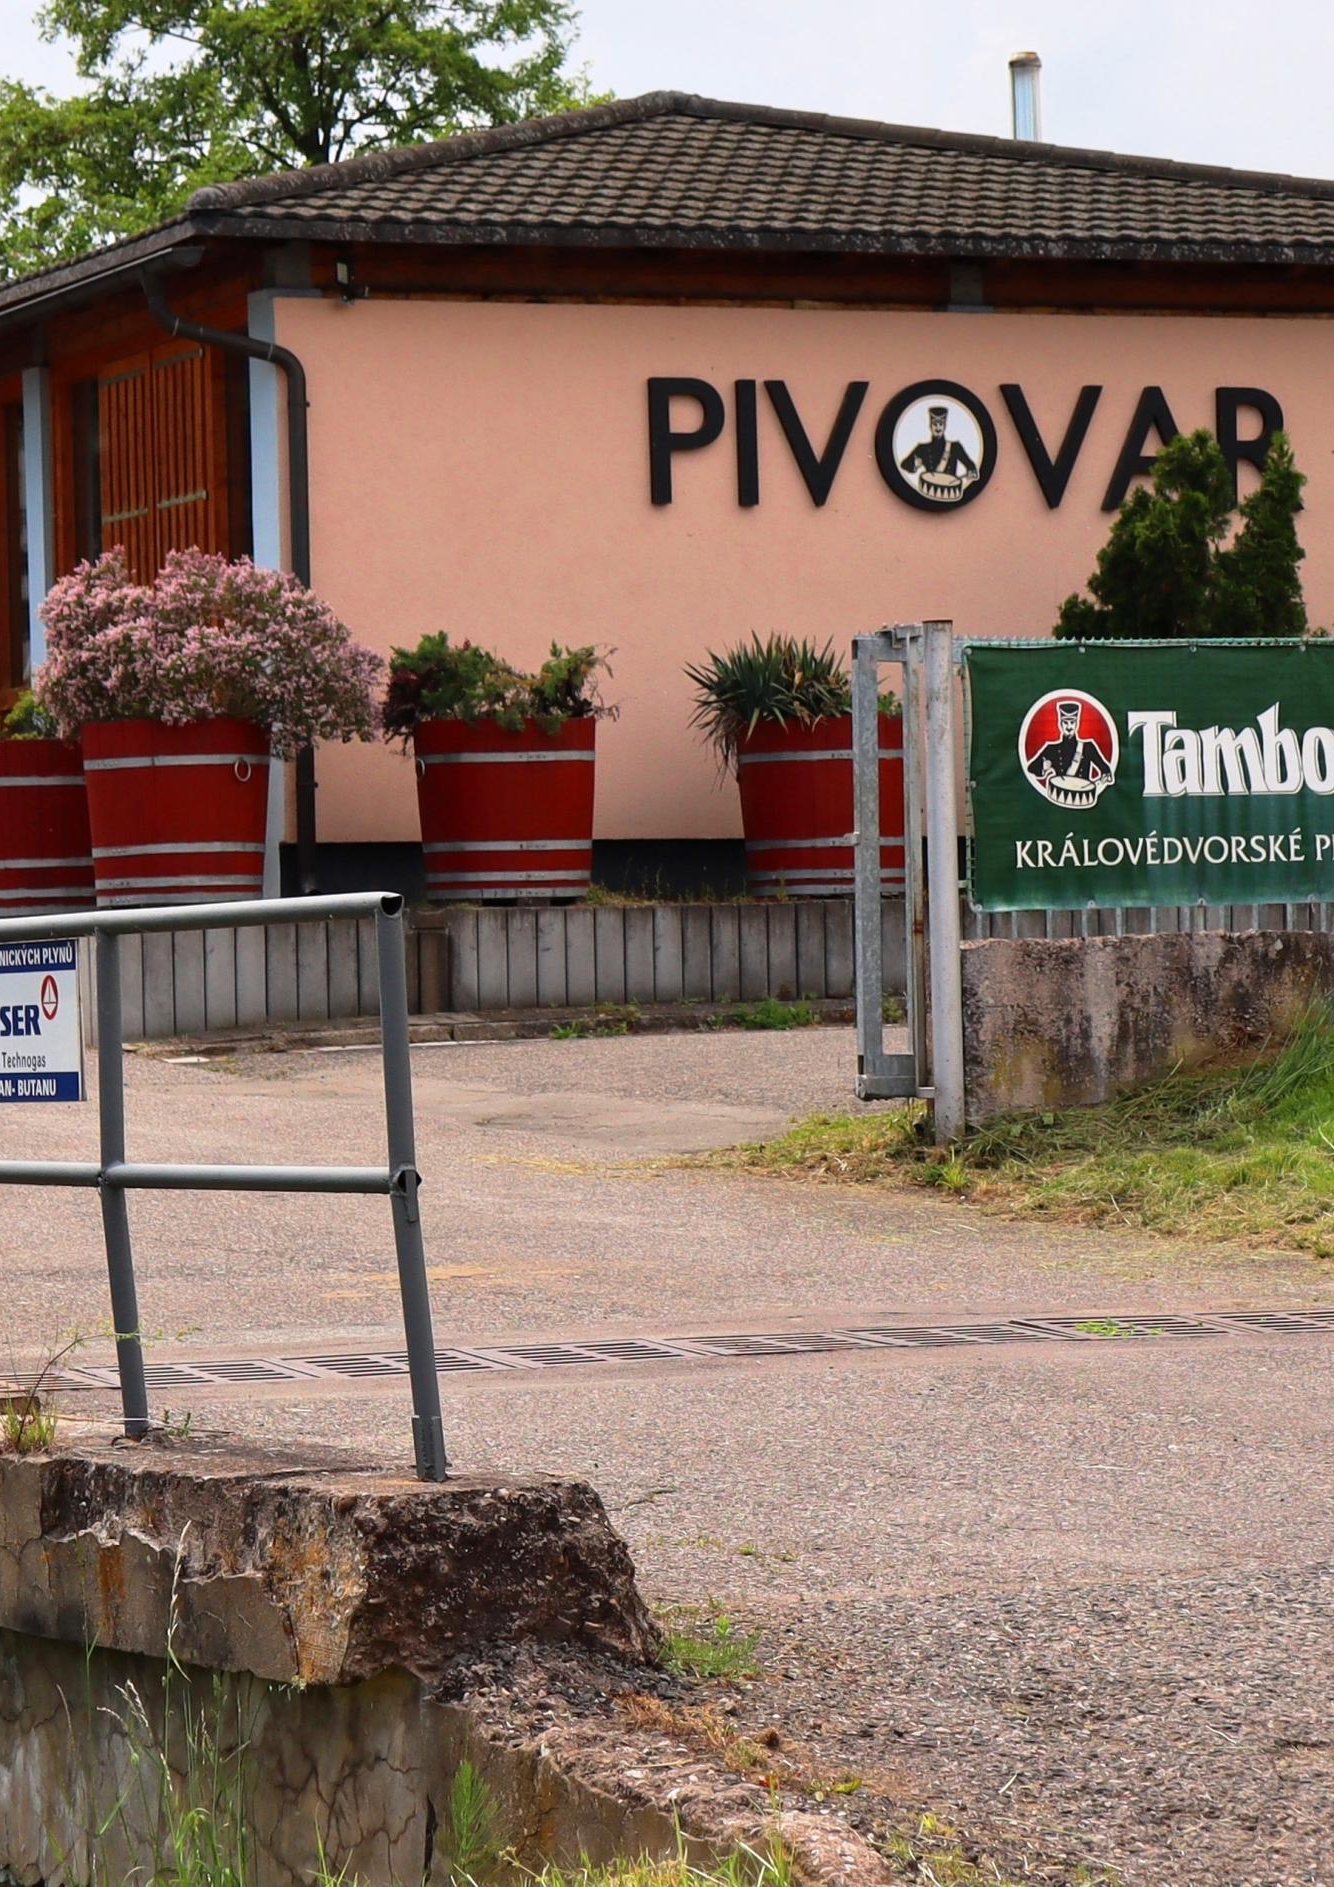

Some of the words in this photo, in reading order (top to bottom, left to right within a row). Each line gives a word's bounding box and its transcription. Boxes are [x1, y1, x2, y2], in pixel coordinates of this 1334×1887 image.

[646, 376, 1305, 512] PIVOVAR
[1015, 828, 1305, 868] KRÁLOVÉDVORSKÉ
[2, 1052, 46, 1072] Technogas
[17, 1079, 56, 1097] BUTANU
